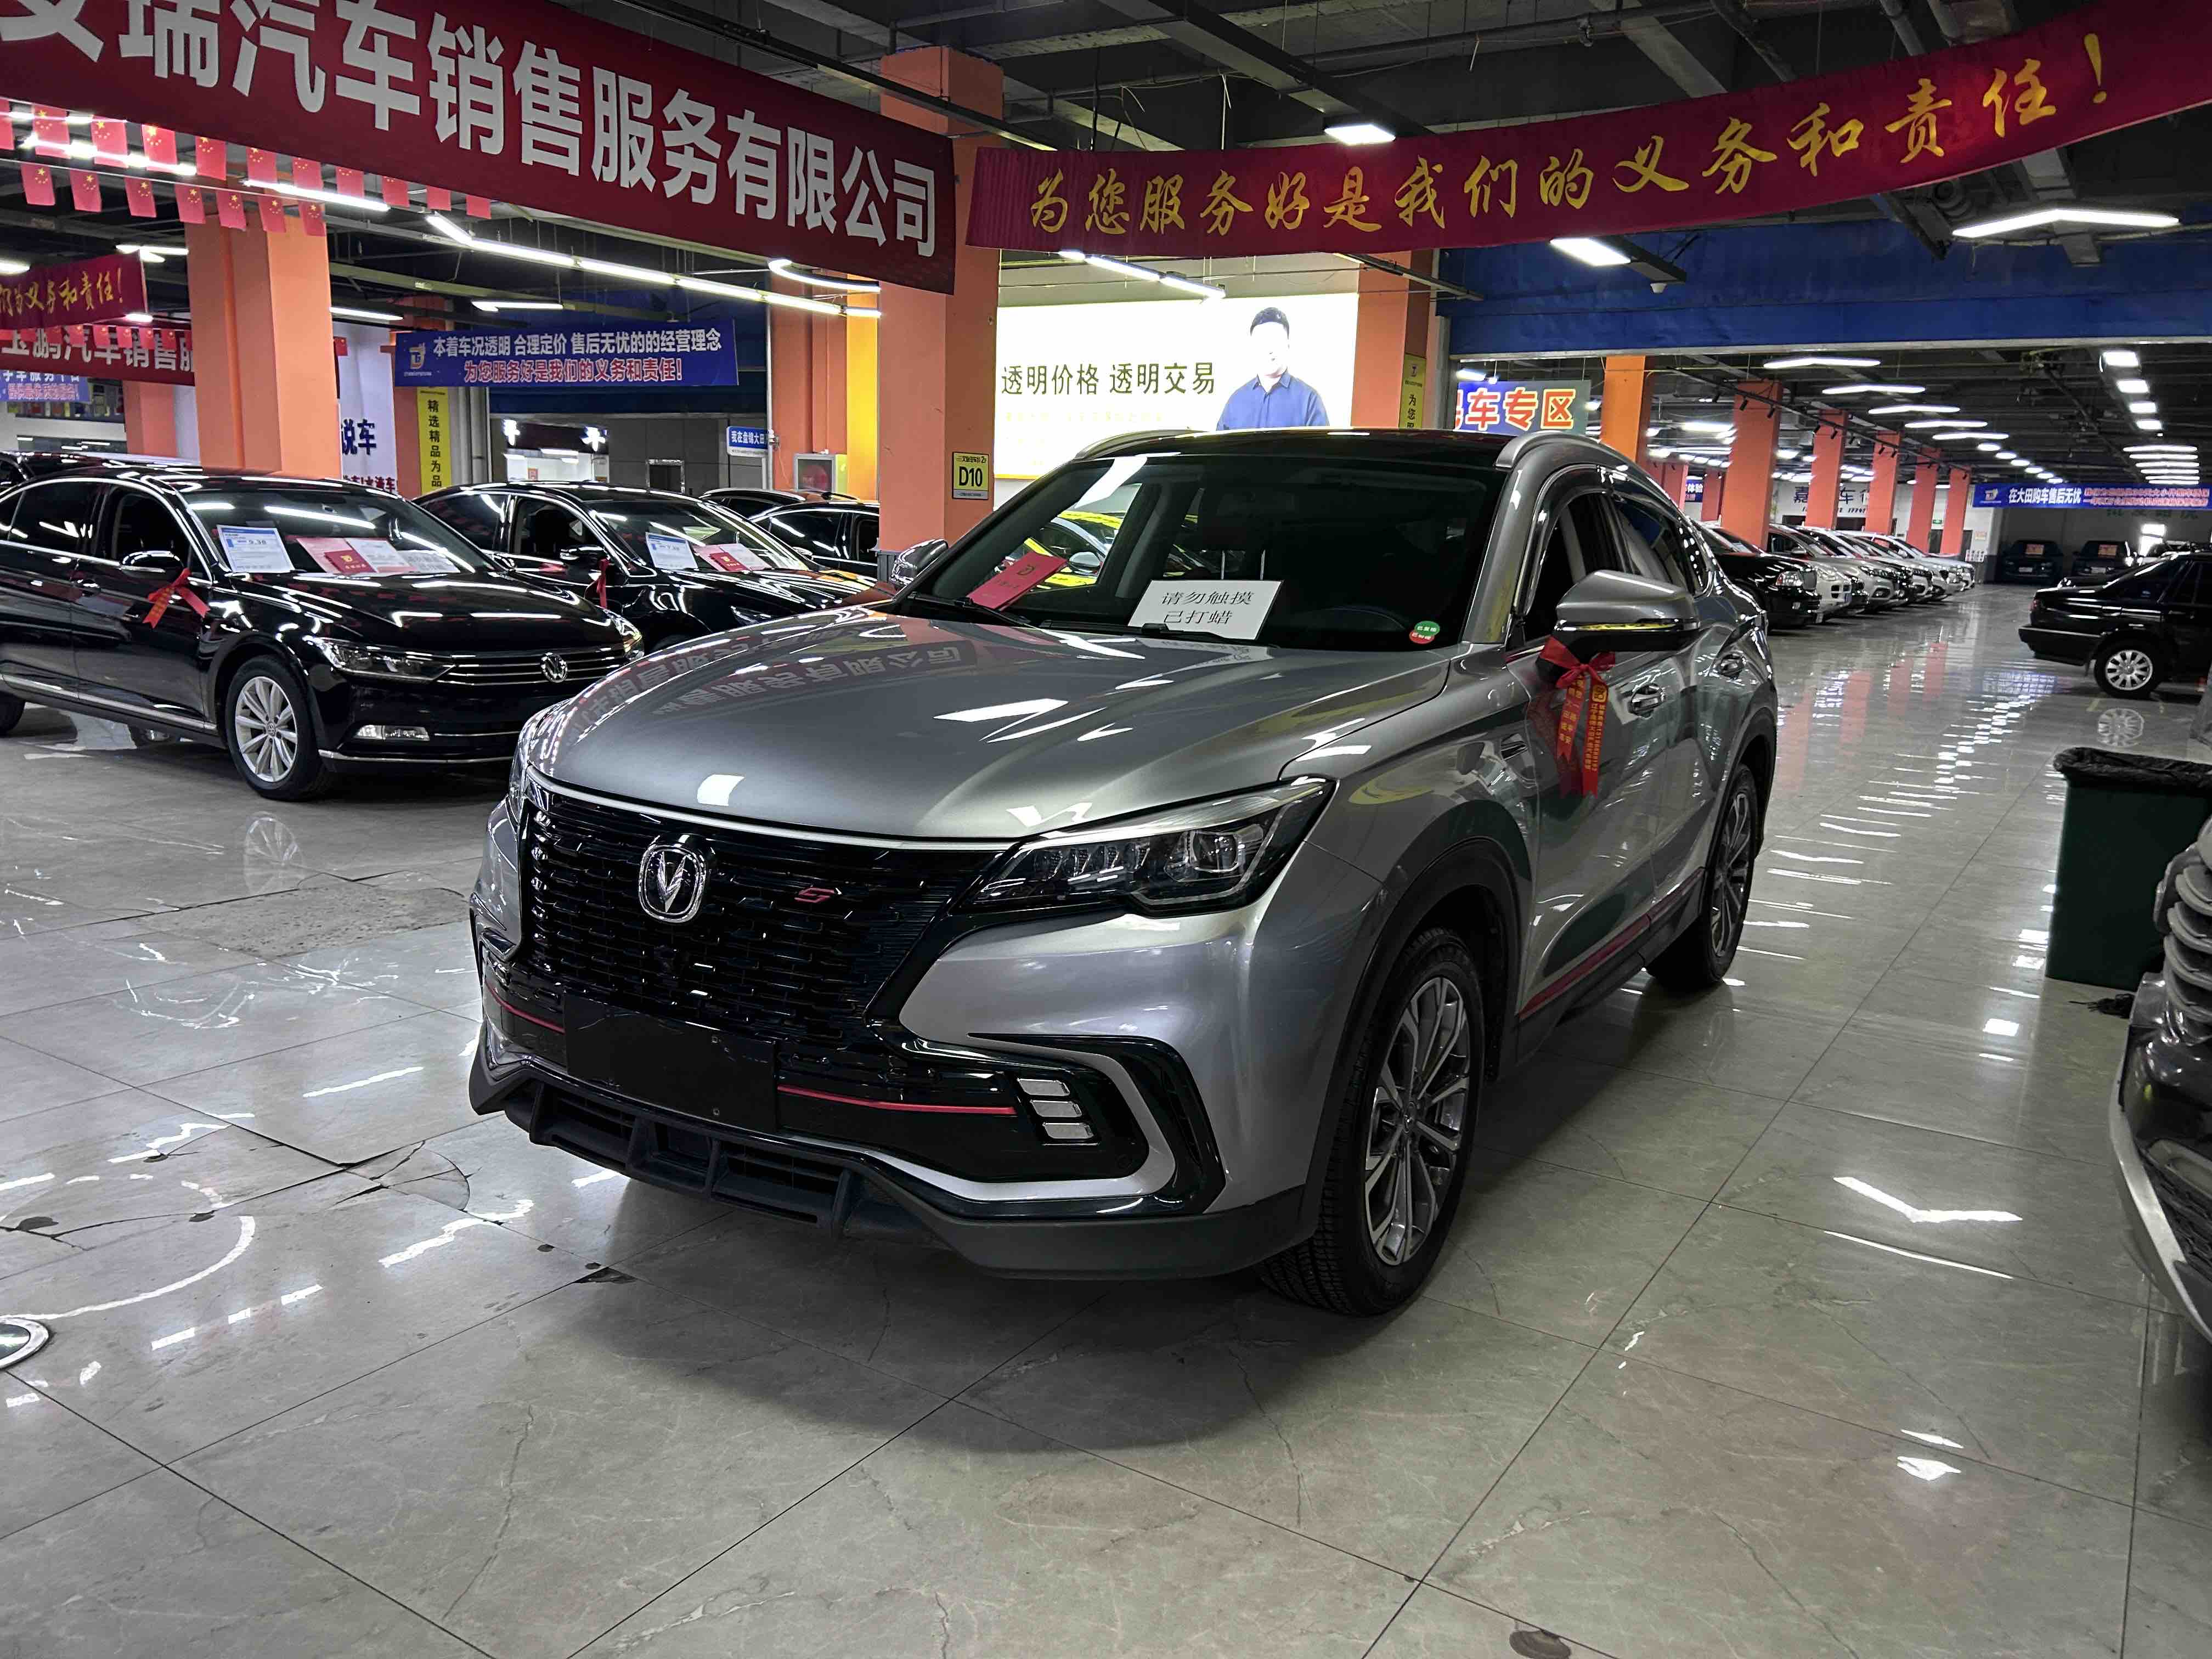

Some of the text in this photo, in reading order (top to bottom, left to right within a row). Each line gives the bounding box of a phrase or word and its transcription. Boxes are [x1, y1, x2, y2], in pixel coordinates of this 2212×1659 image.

[1031, 33, 2107, 235] 为您服务好是我们的义务和责任！
[433, 328, 721, 357] 本着车况透明 合理定价 售后无忧的的经营理念
[464, 358, 683, 383] 为您服务好是我们的义务和责任！
[1001, 362, 1214, 394] 透明价格 透明交易
[958, 466, 983, 487] D10
[1161, 591, 1254, 605] 请勿触摸
[1163, 610, 1233, 624] 已打蜡
